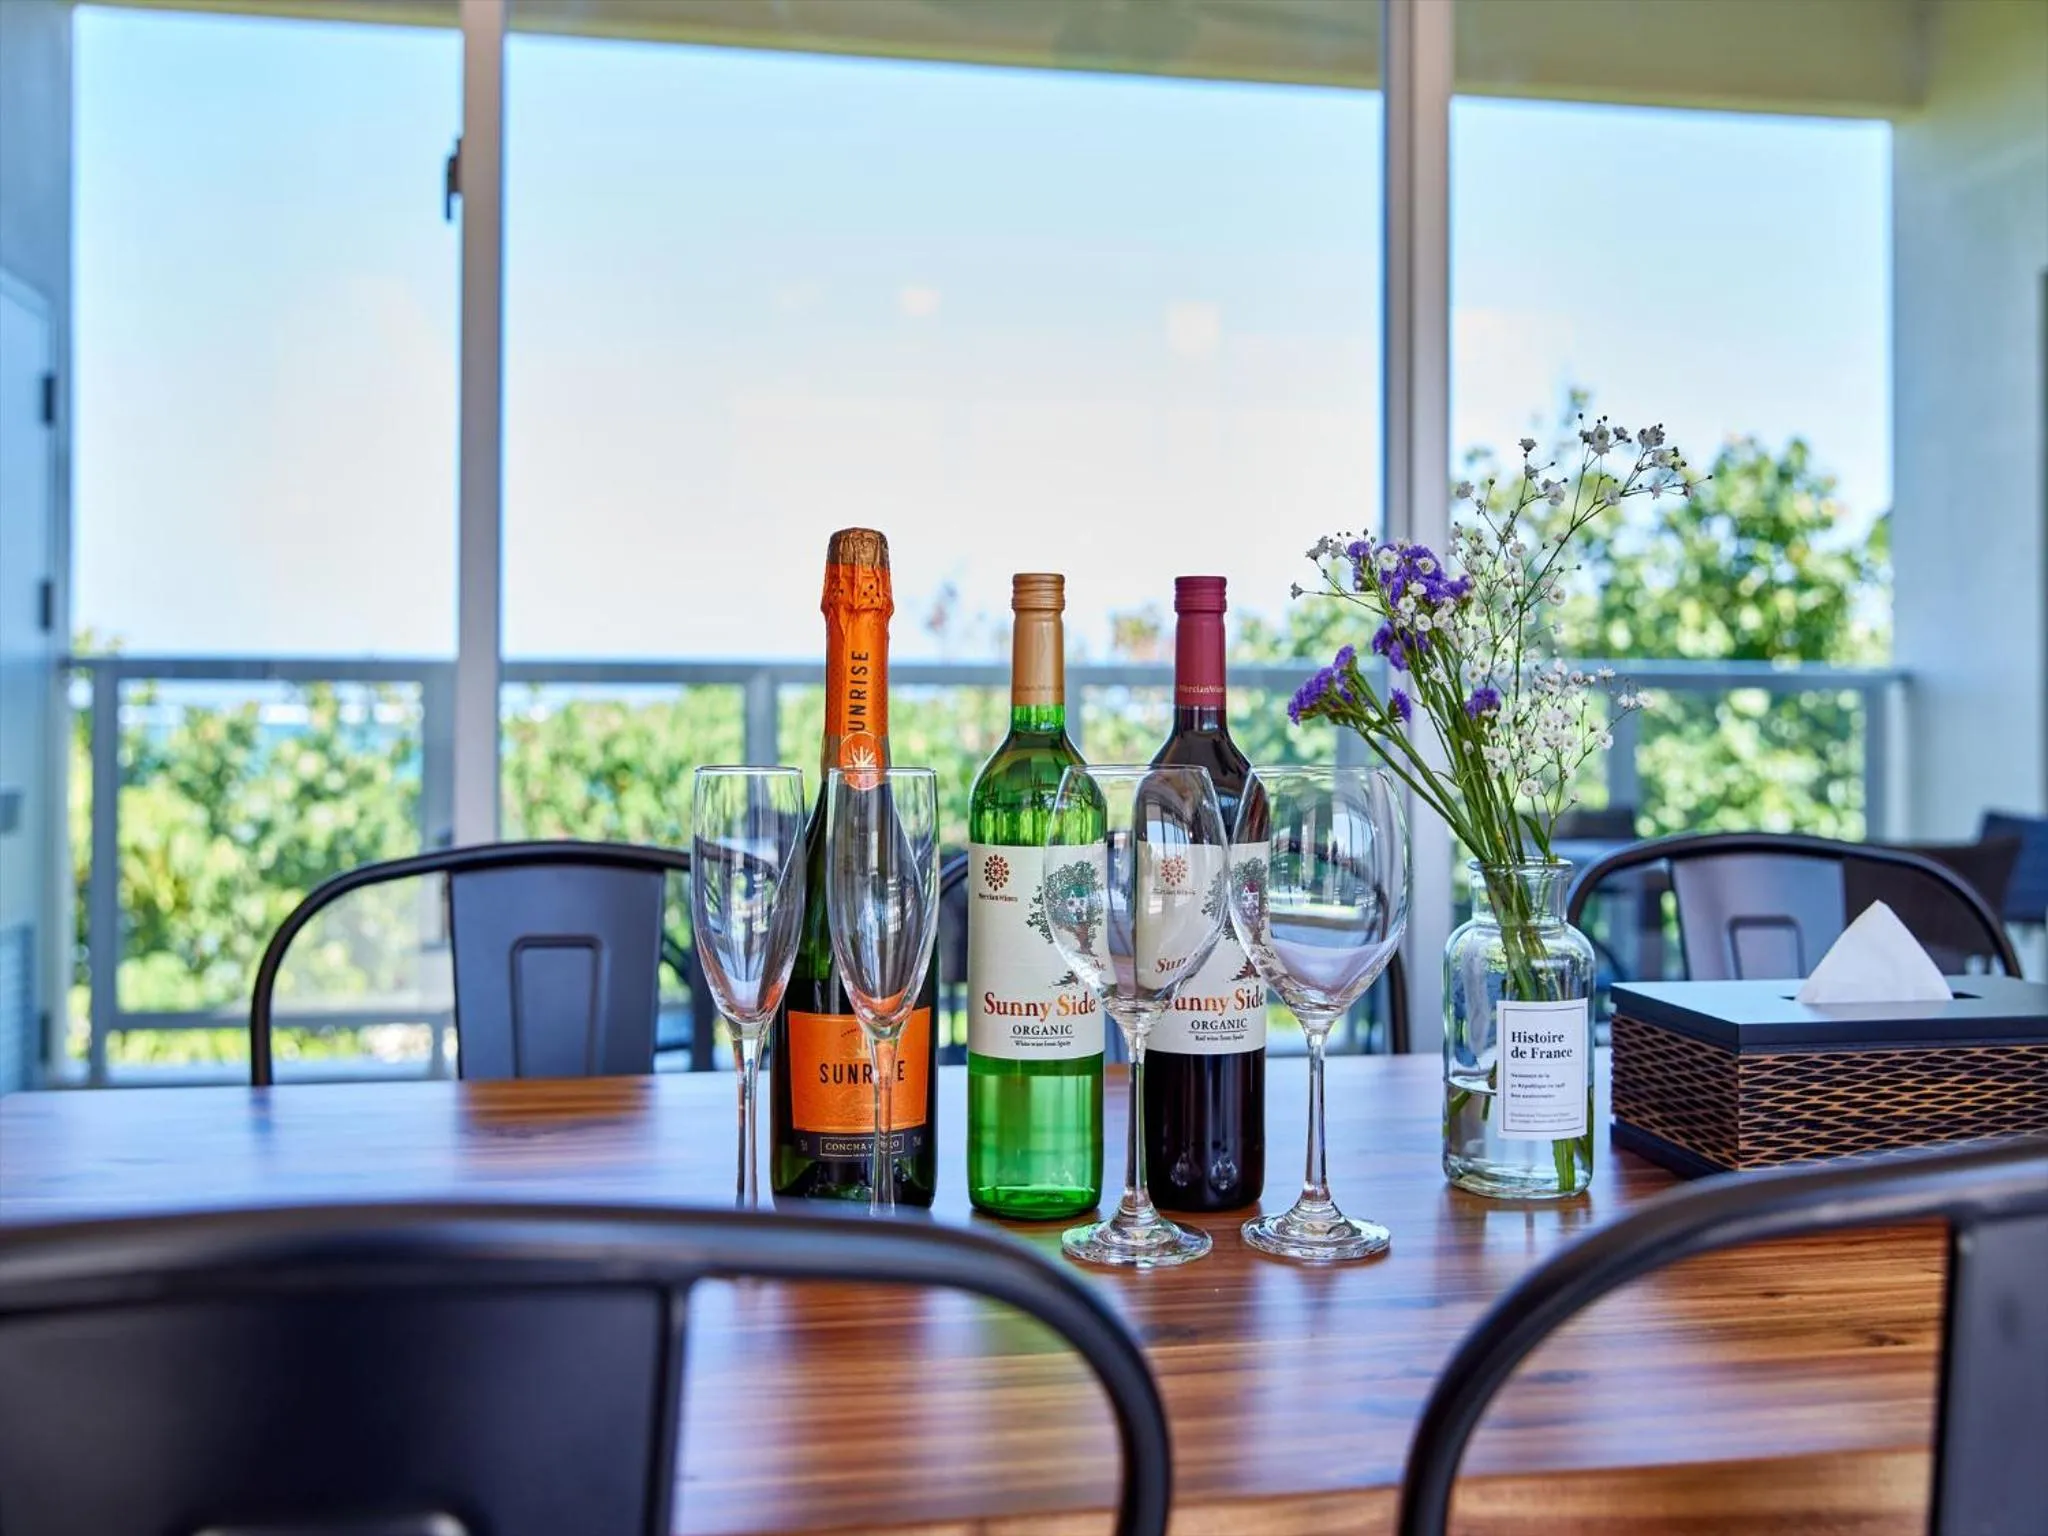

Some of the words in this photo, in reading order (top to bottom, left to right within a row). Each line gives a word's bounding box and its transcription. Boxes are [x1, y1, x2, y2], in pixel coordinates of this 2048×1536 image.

[848, 651, 868, 732] UNRISE
[984, 991, 1053, 1022] Sunny
[1057, 991, 1096, 1016] Side
[1163, 992, 1229, 1016] unny
[1012, 1024, 1073, 1036] ORGANIC
[1191, 1018, 1248, 1031] ORGANIC
[1511, 1031, 1565, 1044] Histoire
[1511, 1047, 1527, 1059] de
[1531, 1047, 1573, 1059] France
[819, 1060, 905, 1085] SUNRE
[825, 1142, 867, 1152] CONCHA
